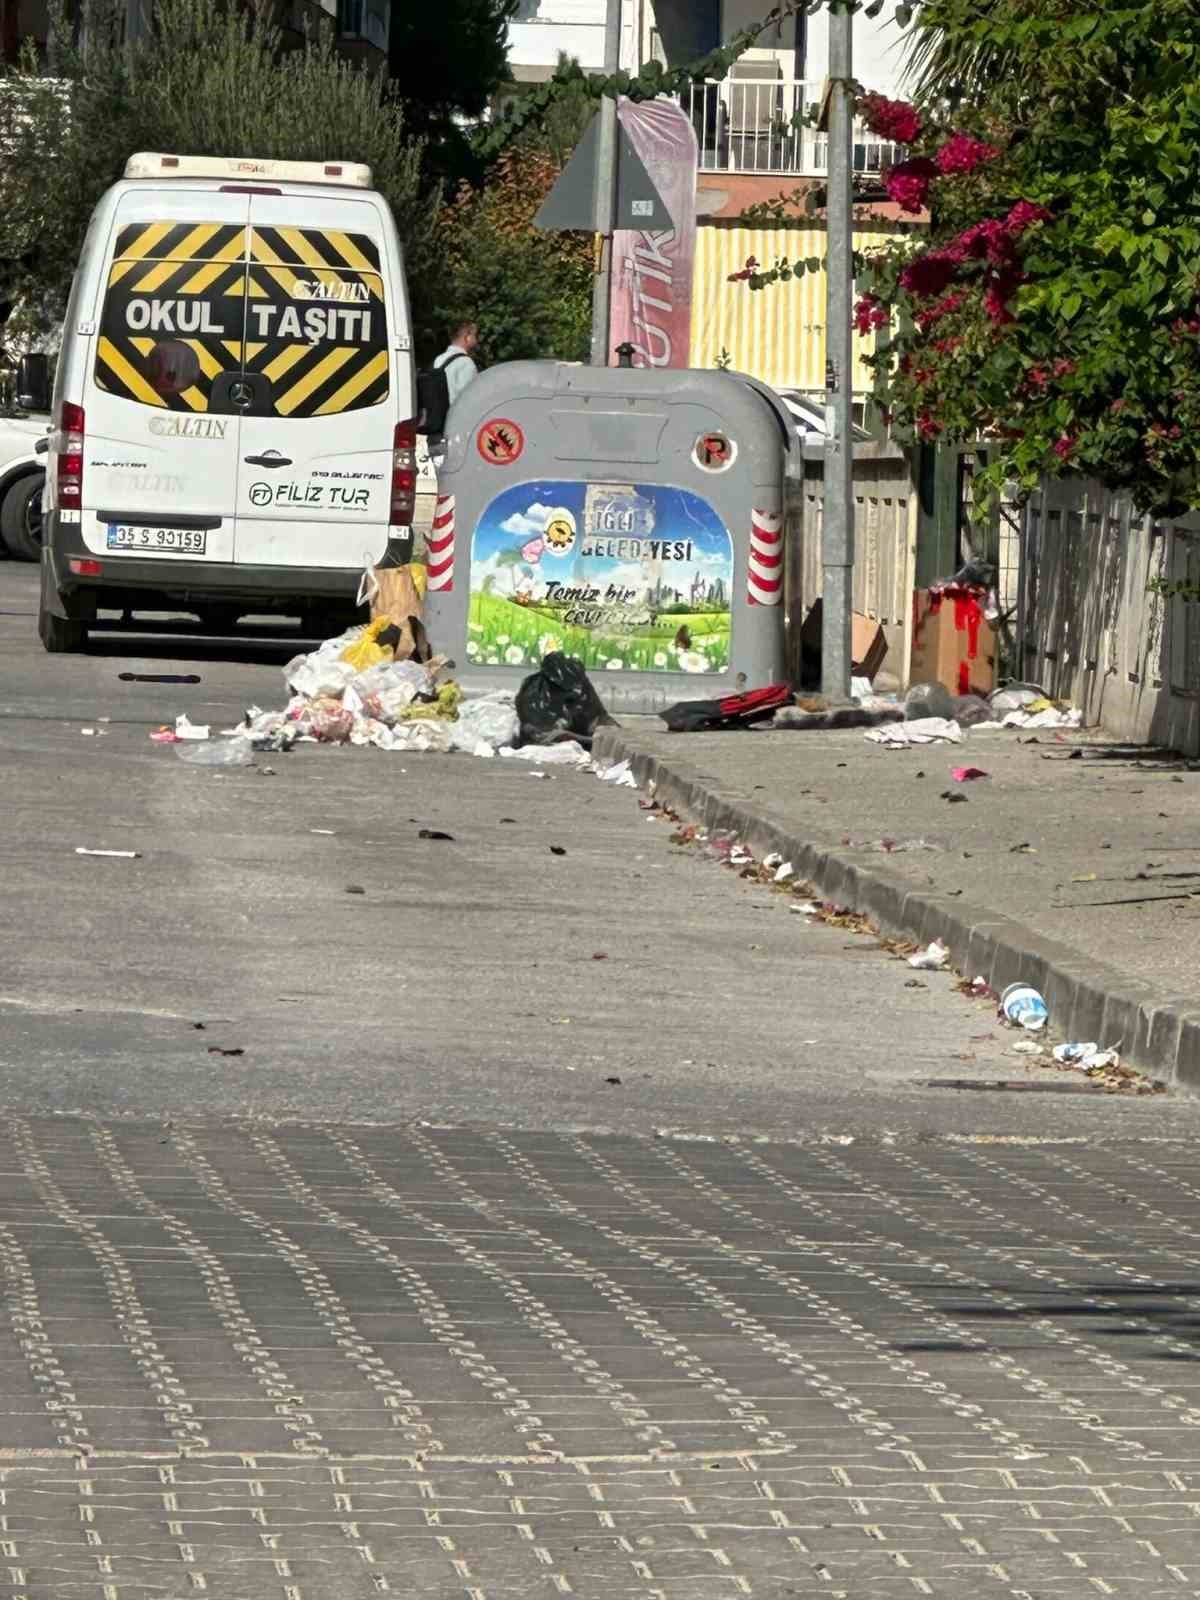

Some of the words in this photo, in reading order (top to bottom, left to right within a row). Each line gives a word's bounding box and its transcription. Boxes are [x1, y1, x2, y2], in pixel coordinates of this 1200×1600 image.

[126, 299, 224, 333] OKUL
[252, 304, 371, 345] TAŞITI
[276, 481, 324, 502] FİLİZ
[330, 486, 370, 505] TUR
